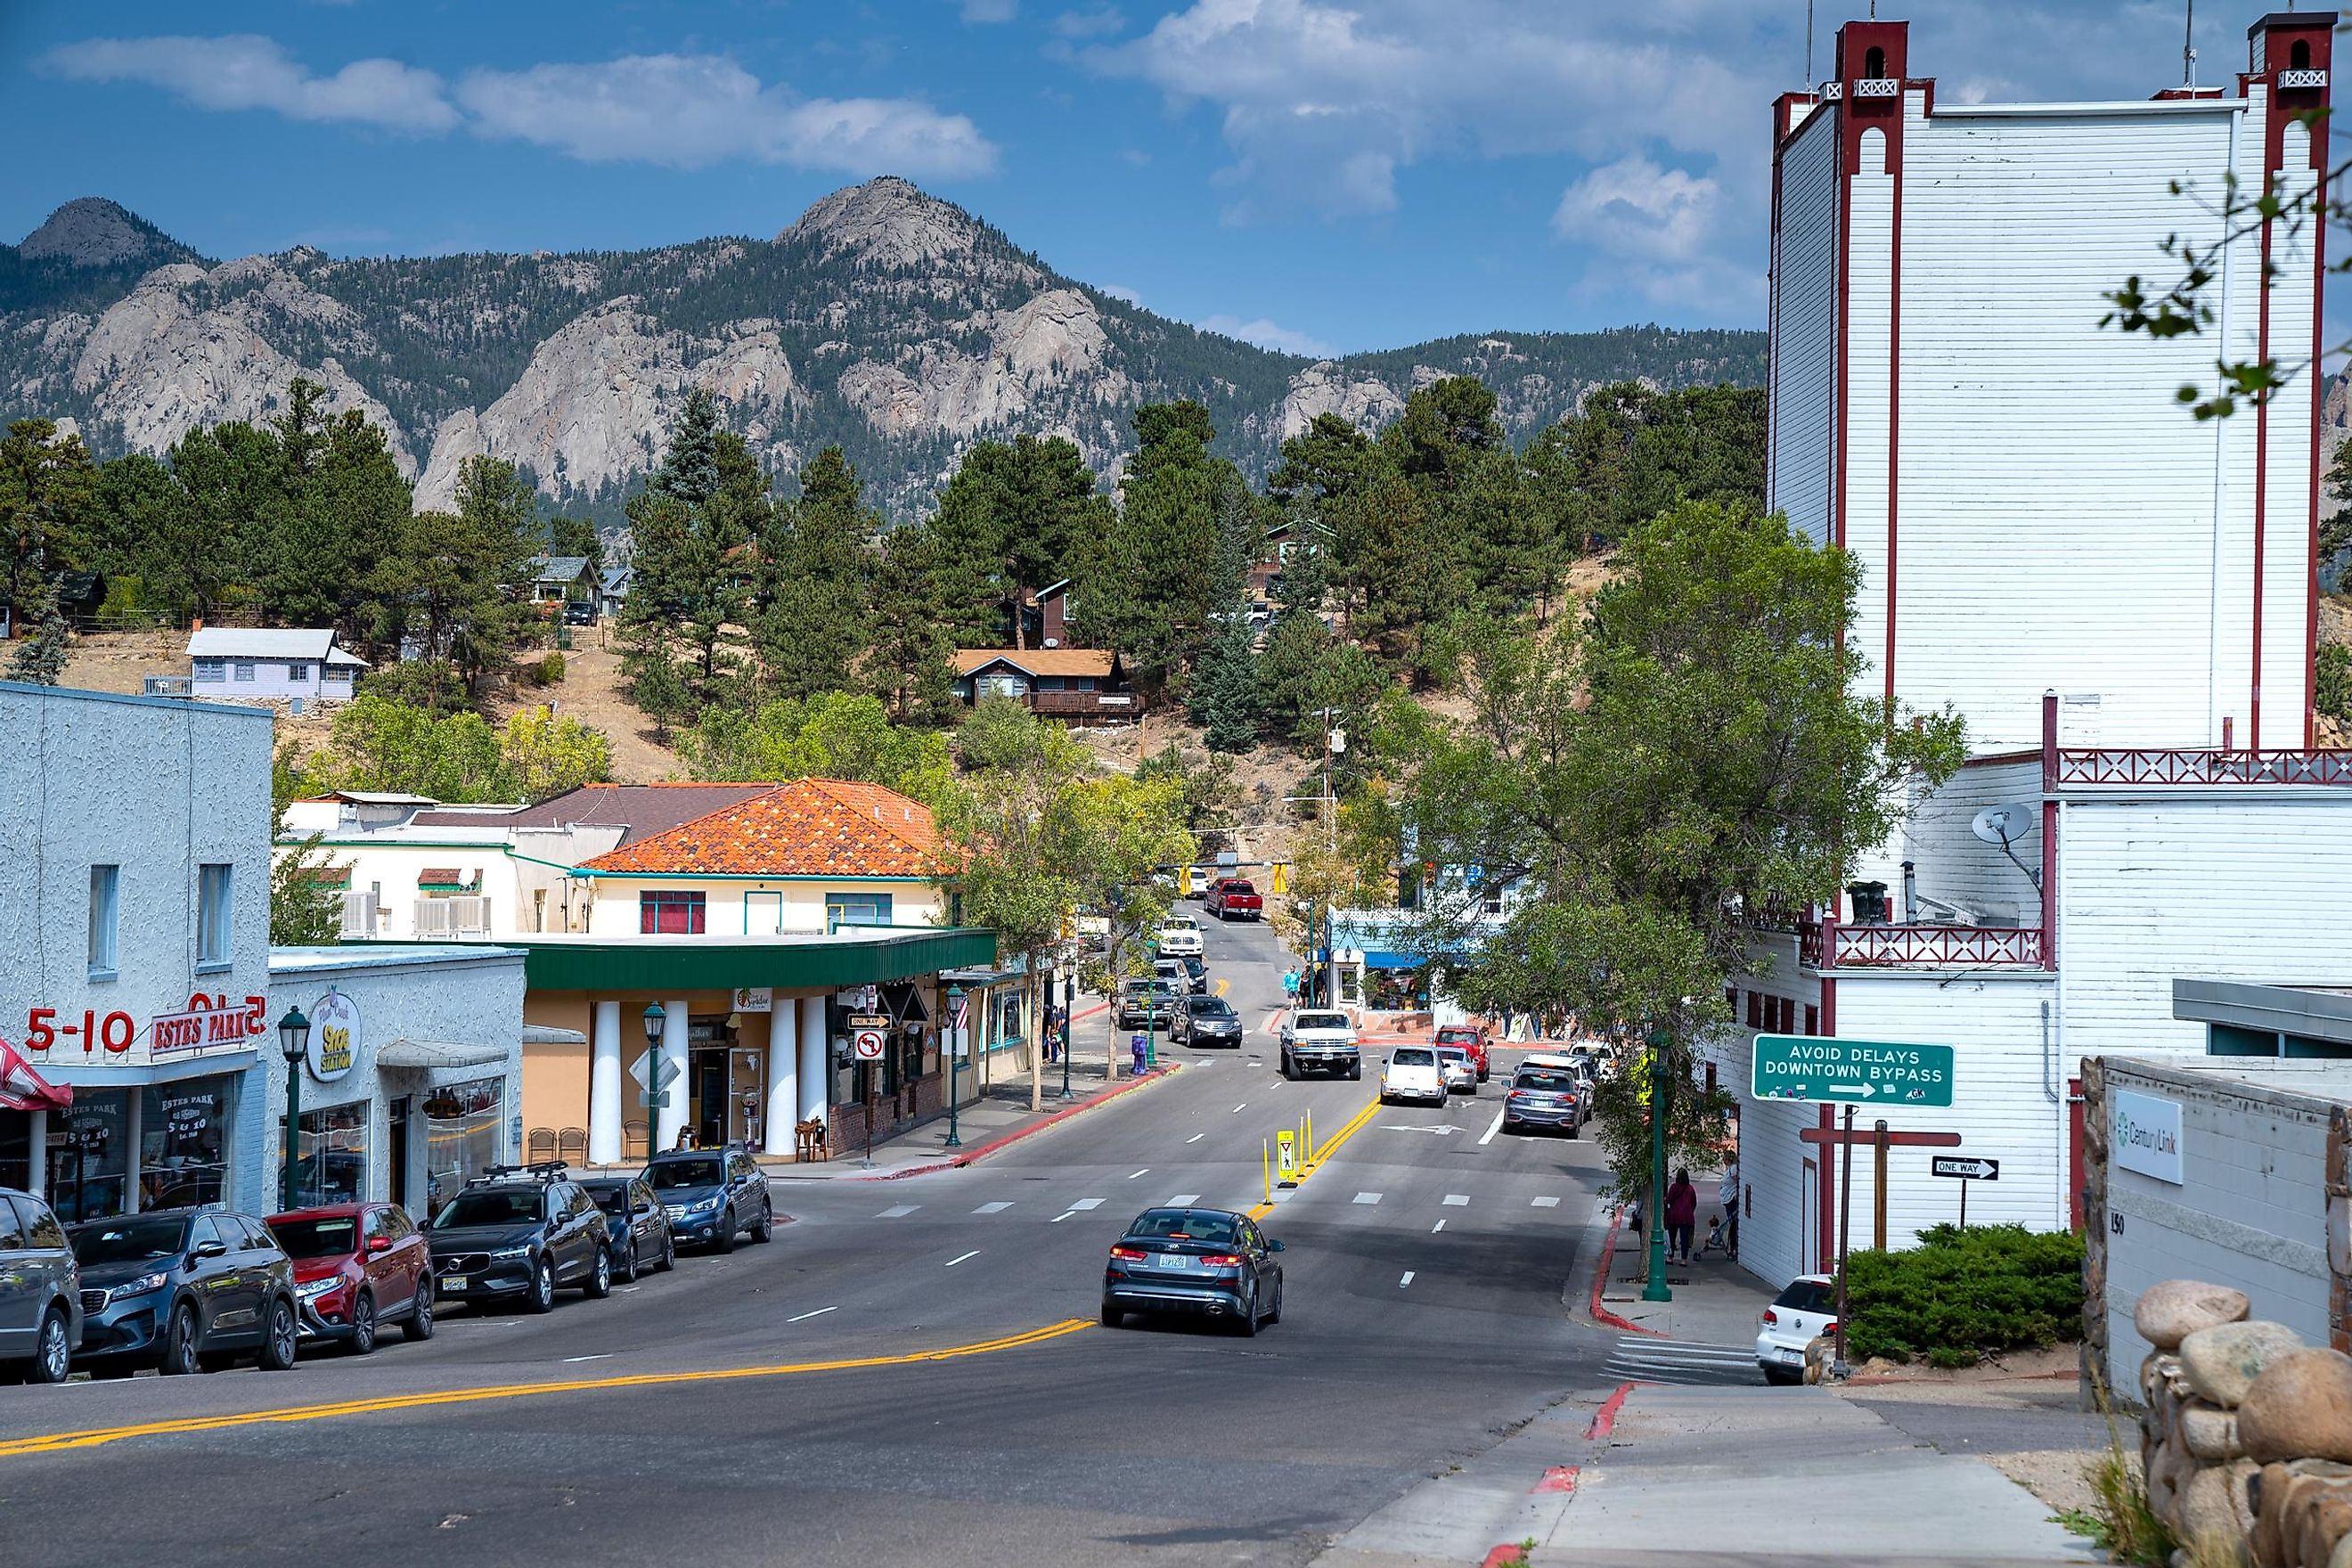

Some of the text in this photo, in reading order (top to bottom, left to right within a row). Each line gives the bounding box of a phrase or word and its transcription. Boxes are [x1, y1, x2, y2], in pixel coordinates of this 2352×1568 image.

[25, 1008, 135, 1053] 5-10
[153, 1011, 246, 1049] ESTES PARK
[321, 1051, 351, 1073] STATION
[1789, 1045, 1920, 1065] AVOID DELAYS
[1765, 1061, 1942, 1082] DOWNTOWN BYPASS
[191, 1094, 214, 1106] PARK
[167, 1123, 176, 1133] 5
[193, 1118, 207, 1130] 10
[69, 1132, 77, 1144] 5
[96, 1128, 109, 1140] 10
[2129, 1121, 2176, 1156] CenturyLink
[1939, 1162, 1979, 1173] ONE WAY
